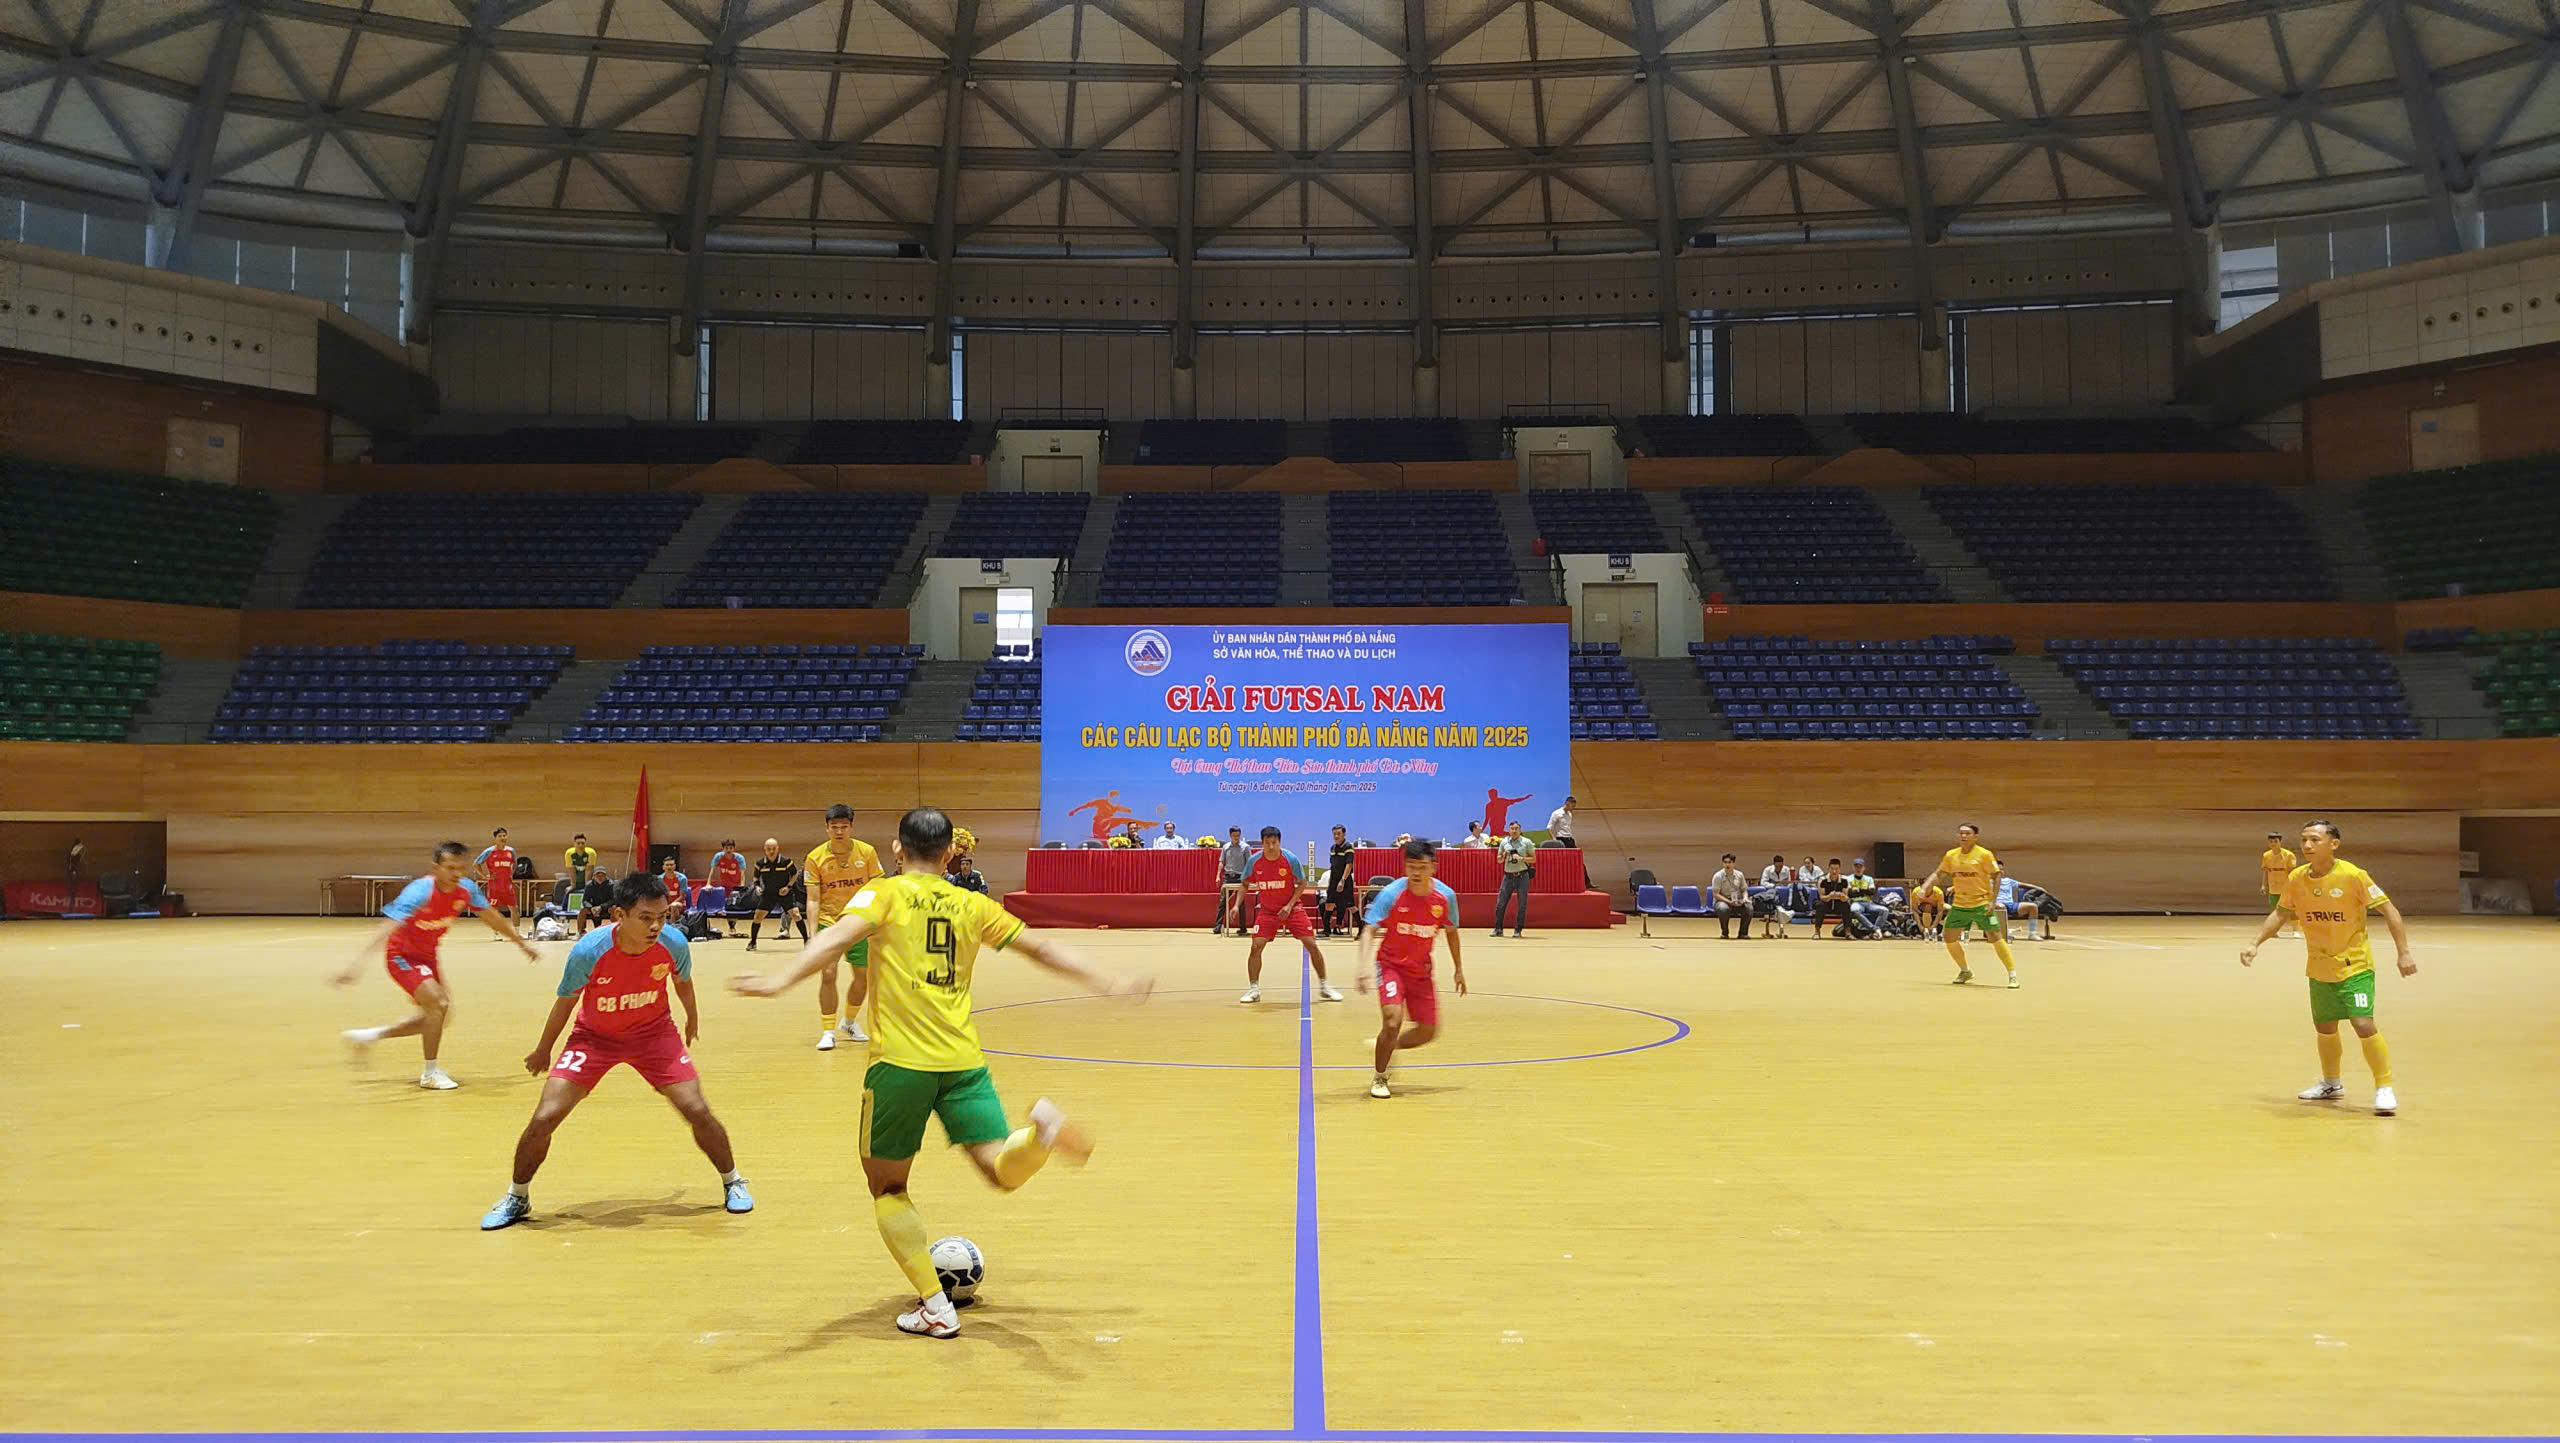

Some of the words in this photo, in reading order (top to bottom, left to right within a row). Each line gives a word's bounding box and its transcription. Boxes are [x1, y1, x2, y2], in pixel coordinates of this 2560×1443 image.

[1610, 557, 1624, 565] KHU
[1213, 630, 1225, 643] ỦY
[1227, 633, 1247, 644] BAN
[1249, 631, 1275, 644] NHÂN
[1277, 631, 1297, 644] DÂN
[1299, 631, 1330, 644] THÀNH
[1332, 630, 1353, 644] PHỐ
[1354, 631, 1368, 644] ĐÀ
[1369, 630, 1396, 644] NẴNG
[1213, 645, 1228, 659] SỞ
[1231, 647, 1252, 659] VĂN
[1254, 646, 1280, 660] HÓA,
[1283, 644, 1303, 659] THỂ
[1306, 648, 1335, 659] THAO
[1338, 646, 1351, 659] VÀ
[1353, 648, 1369, 659] DU
[1371, 648, 1396, 661] LỊCH
[1165, 674, 1235, 712] GIẢI
[1243, 684, 1364, 712] FUTSAL
[1372, 684, 1446, 712] NAM
[1081, 722, 1118, 748] CÁC
[1124, 722, 1161, 748] CÂU
[1166, 726, 1201, 752] LẠC
[1206, 722, 1232, 752] BỘ
[1236, 722, 1298, 748] THÀNH
[1302, 719, 1341, 748] PHỐ
[1345, 722, 1371, 748] ĐÀ
[1375, 720, 1429, 748] NẴNG
[1433, 722, 1478, 748] NĂM
[1482, 726, 1529, 748] 2025
[1228, 783, 1247, 793] ngày
[1249, 782, 1257, 791] 16
[1275, 783, 1294, 793] ngày
[1296, 782, 1305, 791] 20
[1306, 782, 1328, 794] tháng
[1331, 782, 1339, 791] 12
[1340, 782, 1357, 791] năm
[1359, 782, 1377, 791] 2025
[926, 917, 957, 985] 9
[1385, 981, 1397, 997] 9
[597, 996, 617, 1012] CB
[2354, 993, 2368, 1008] 18
[556, 1050, 587, 1072] 32
